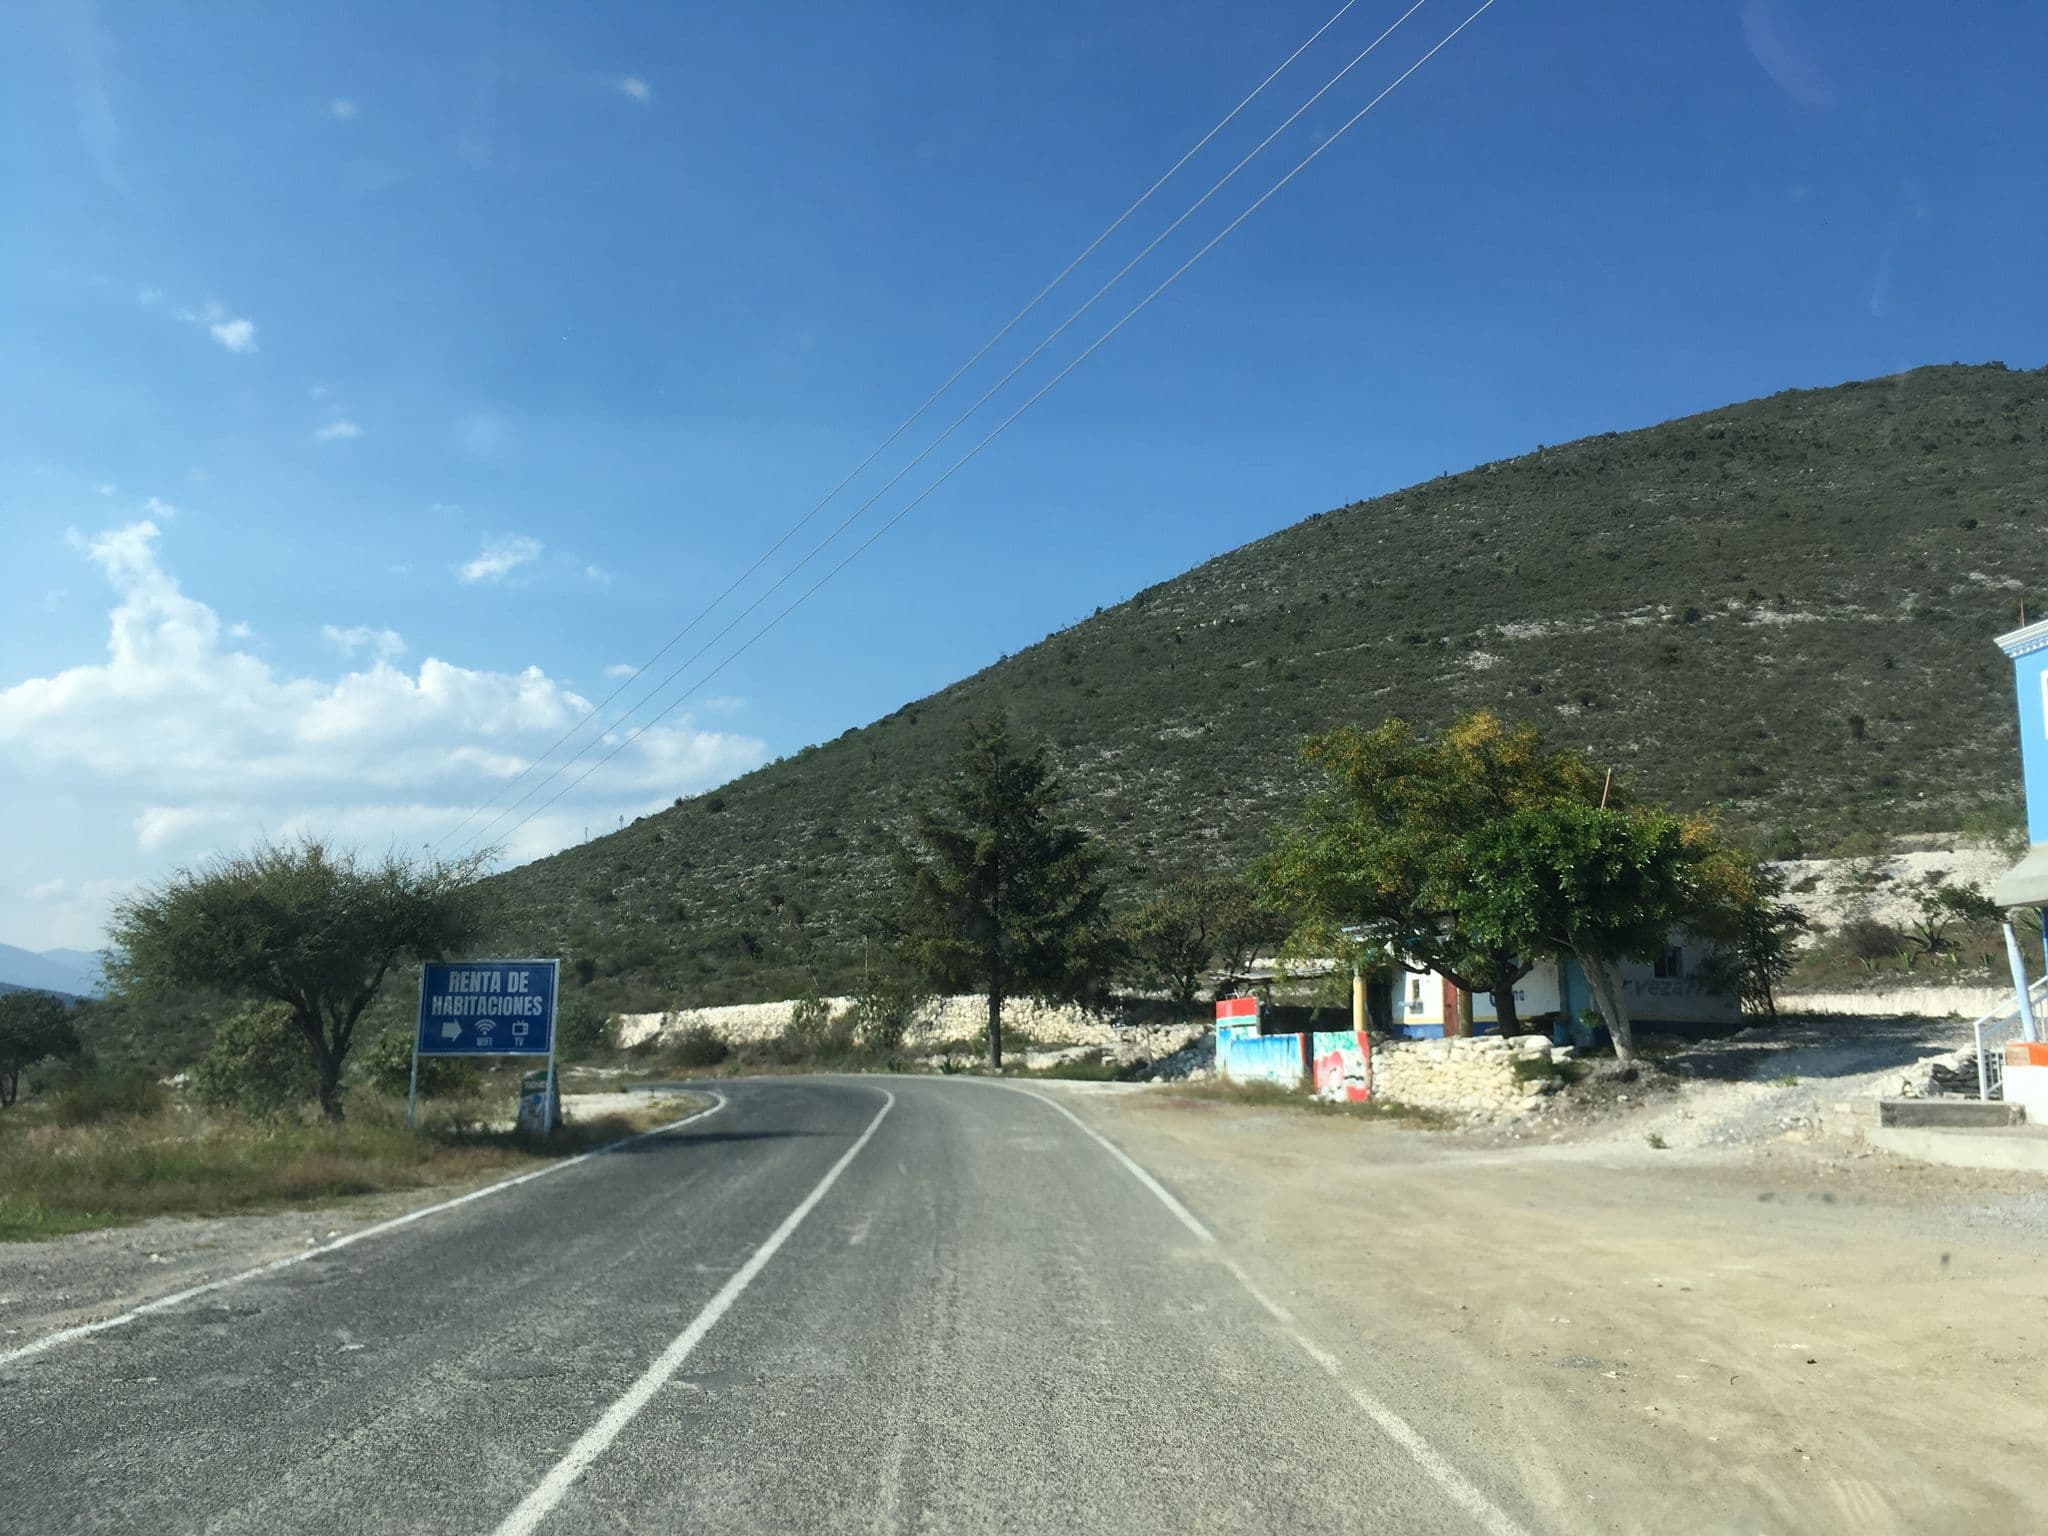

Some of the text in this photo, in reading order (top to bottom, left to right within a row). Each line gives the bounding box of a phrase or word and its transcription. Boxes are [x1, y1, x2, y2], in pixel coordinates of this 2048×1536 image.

[448, 970, 530, 993] RENTA DE
[431, 995, 543, 1017] HABITACIONES
[514, 1037, 525, 1047] TV
